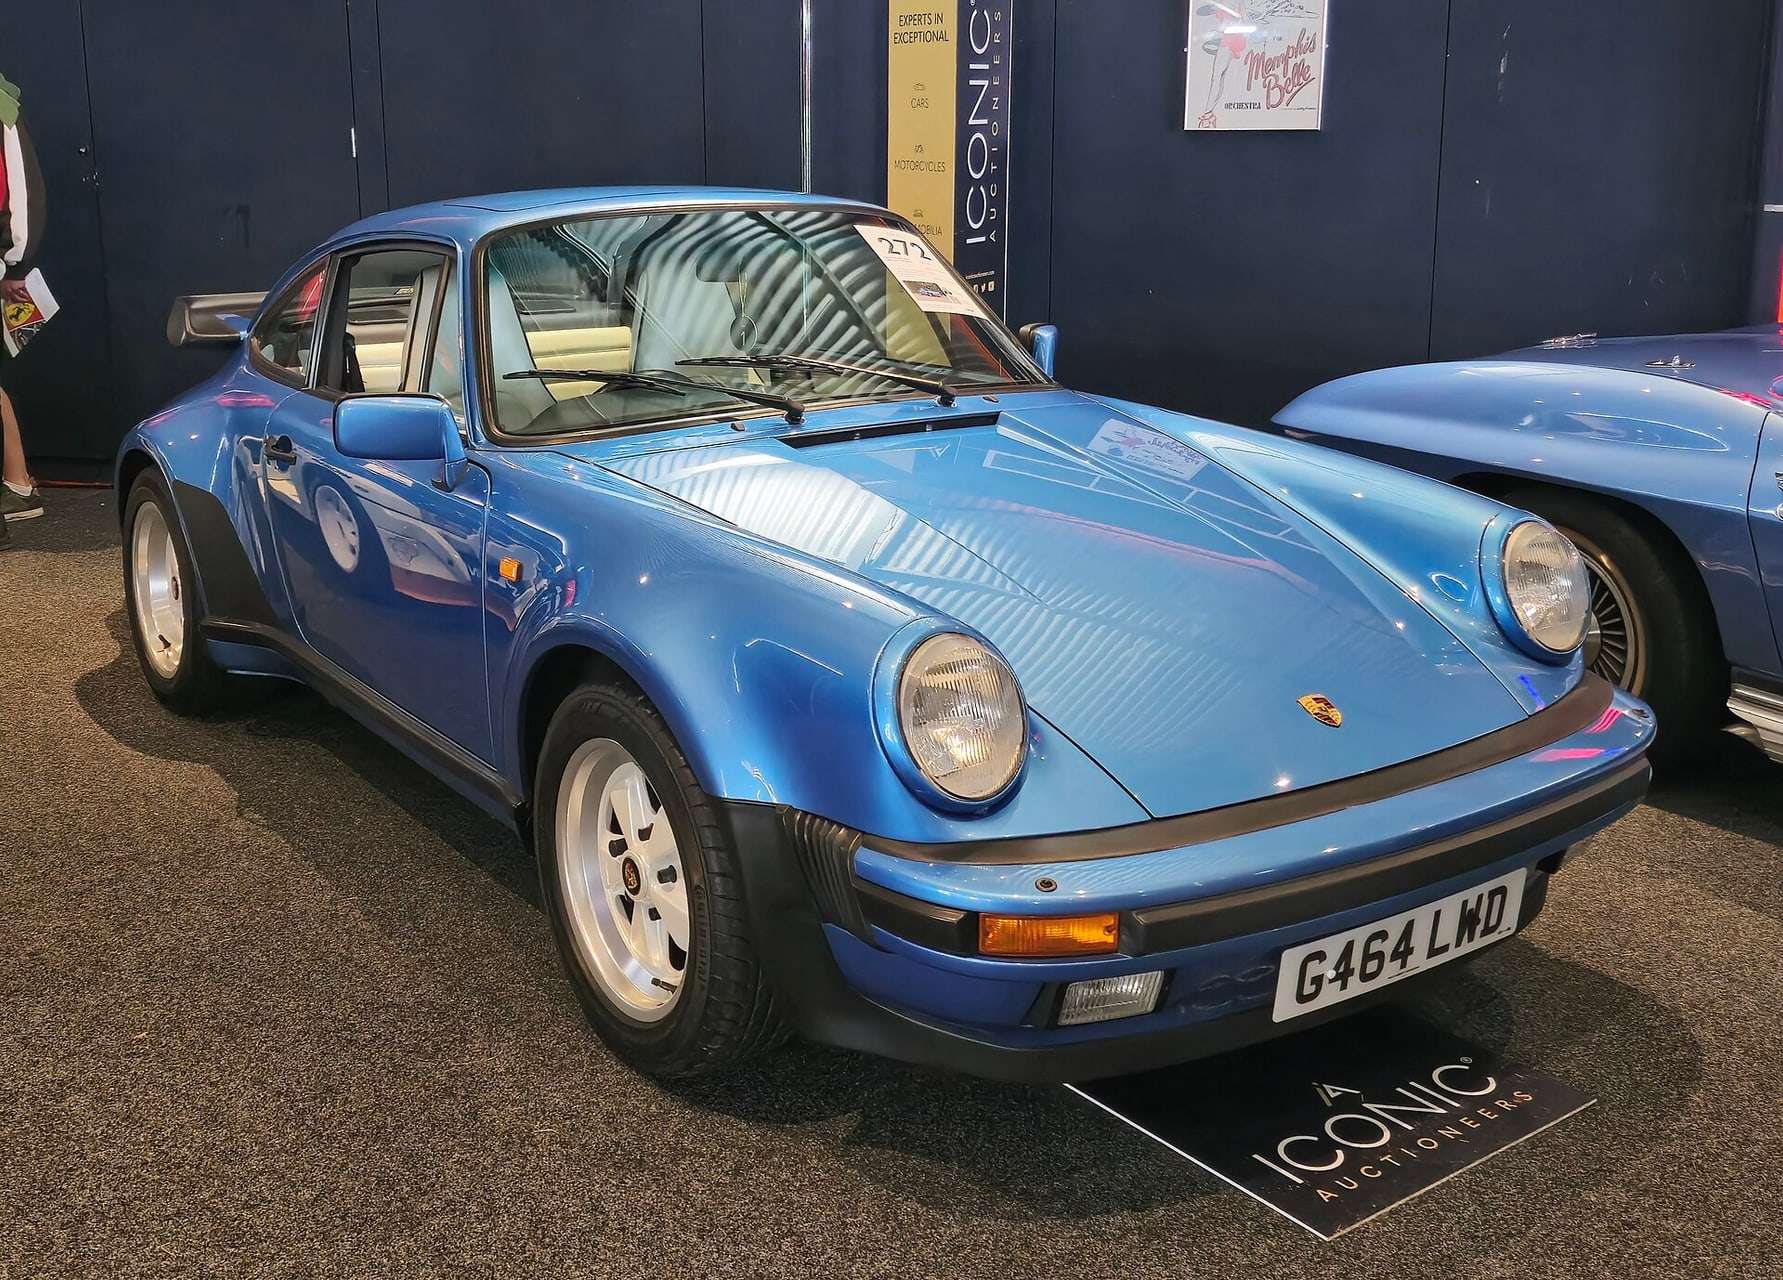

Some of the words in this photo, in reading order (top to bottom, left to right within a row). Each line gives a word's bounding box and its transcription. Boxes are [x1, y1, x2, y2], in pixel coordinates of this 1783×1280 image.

[893, 30, 950, 44] EXCEPTIONAL
[898, 12, 933, 27] EXPERTS
[934, 12, 944, 25] IN
[1244, 27, 1317, 91] Memphis
[1263, 58, 1312, 110] Belle
[910, 97, 929, 109] CARS
[966, 8, 991, 244] ICONIC
[989, 10, 1001, 242] AUCTIONEERS
[894, 159, 946, 173] MOTORCYCLES
[877, 237, 932, 261] 272
[1295, 919, 1415, 1004] G464
[1427, 885, 1508, 960] LWD
[1252, 1065, 1497, 1184] ICONIC
[1315, 1090, 1534, 1203] AUCTIONEERS
